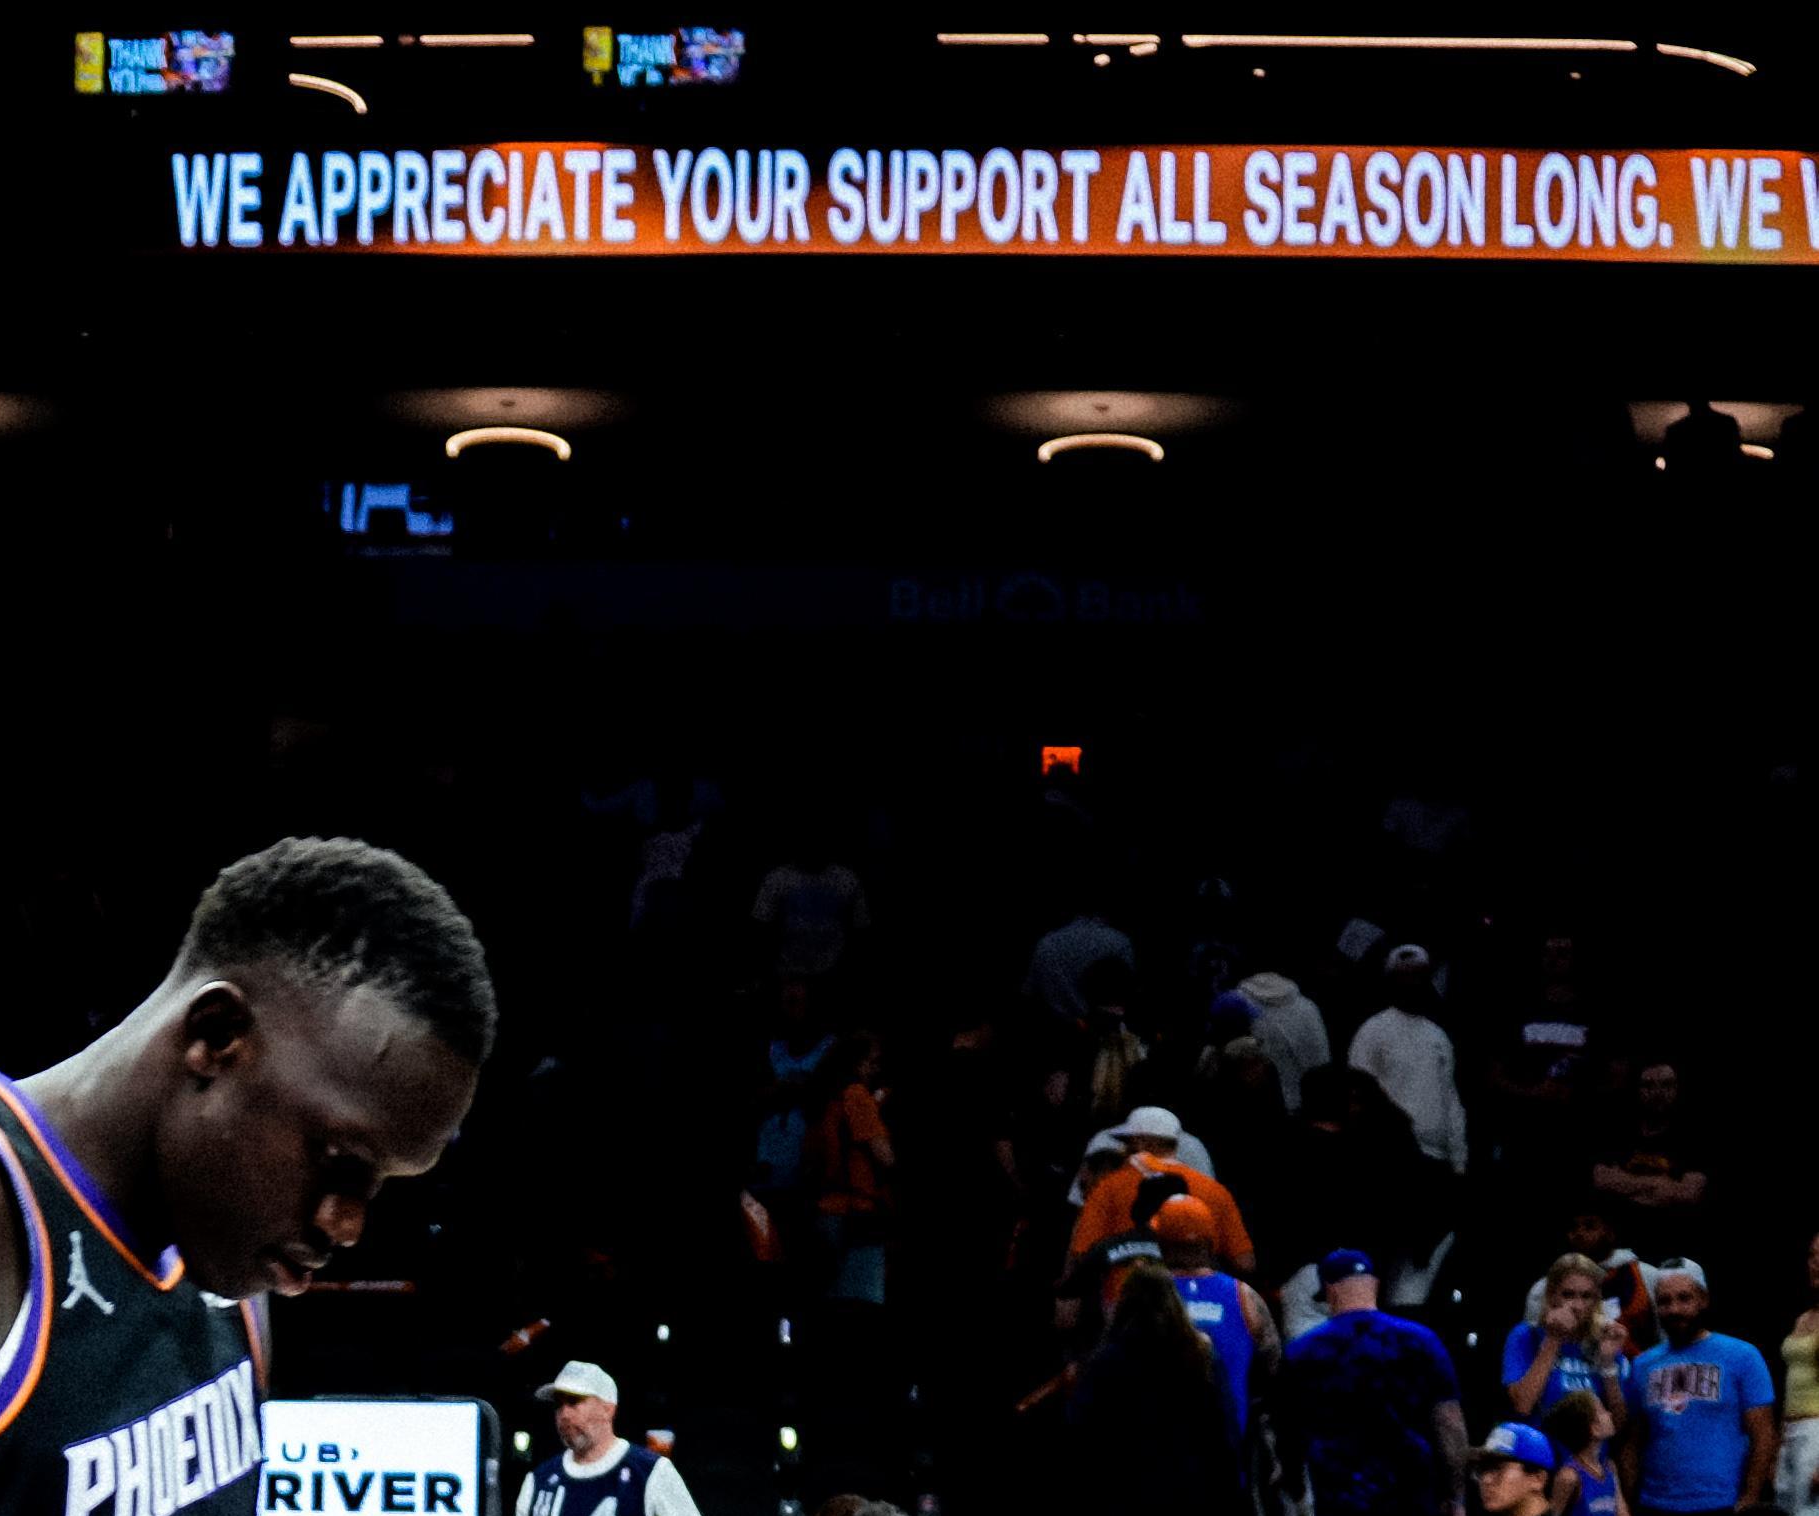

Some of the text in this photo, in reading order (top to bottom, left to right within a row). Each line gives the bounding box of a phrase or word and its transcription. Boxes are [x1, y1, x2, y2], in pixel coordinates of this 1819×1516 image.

[172, 151, 263, 247] WE
[279, 149, 637, 246] APPRECIATE
[652, 147, 811, 244] YOUR
[826, 147, 1101, 244] SUPPORT
[1115, 150, 1227, 246] ALL
[1689, 156, 1782, 251] WE
[265, 1470, 463, 1513] RIVER
